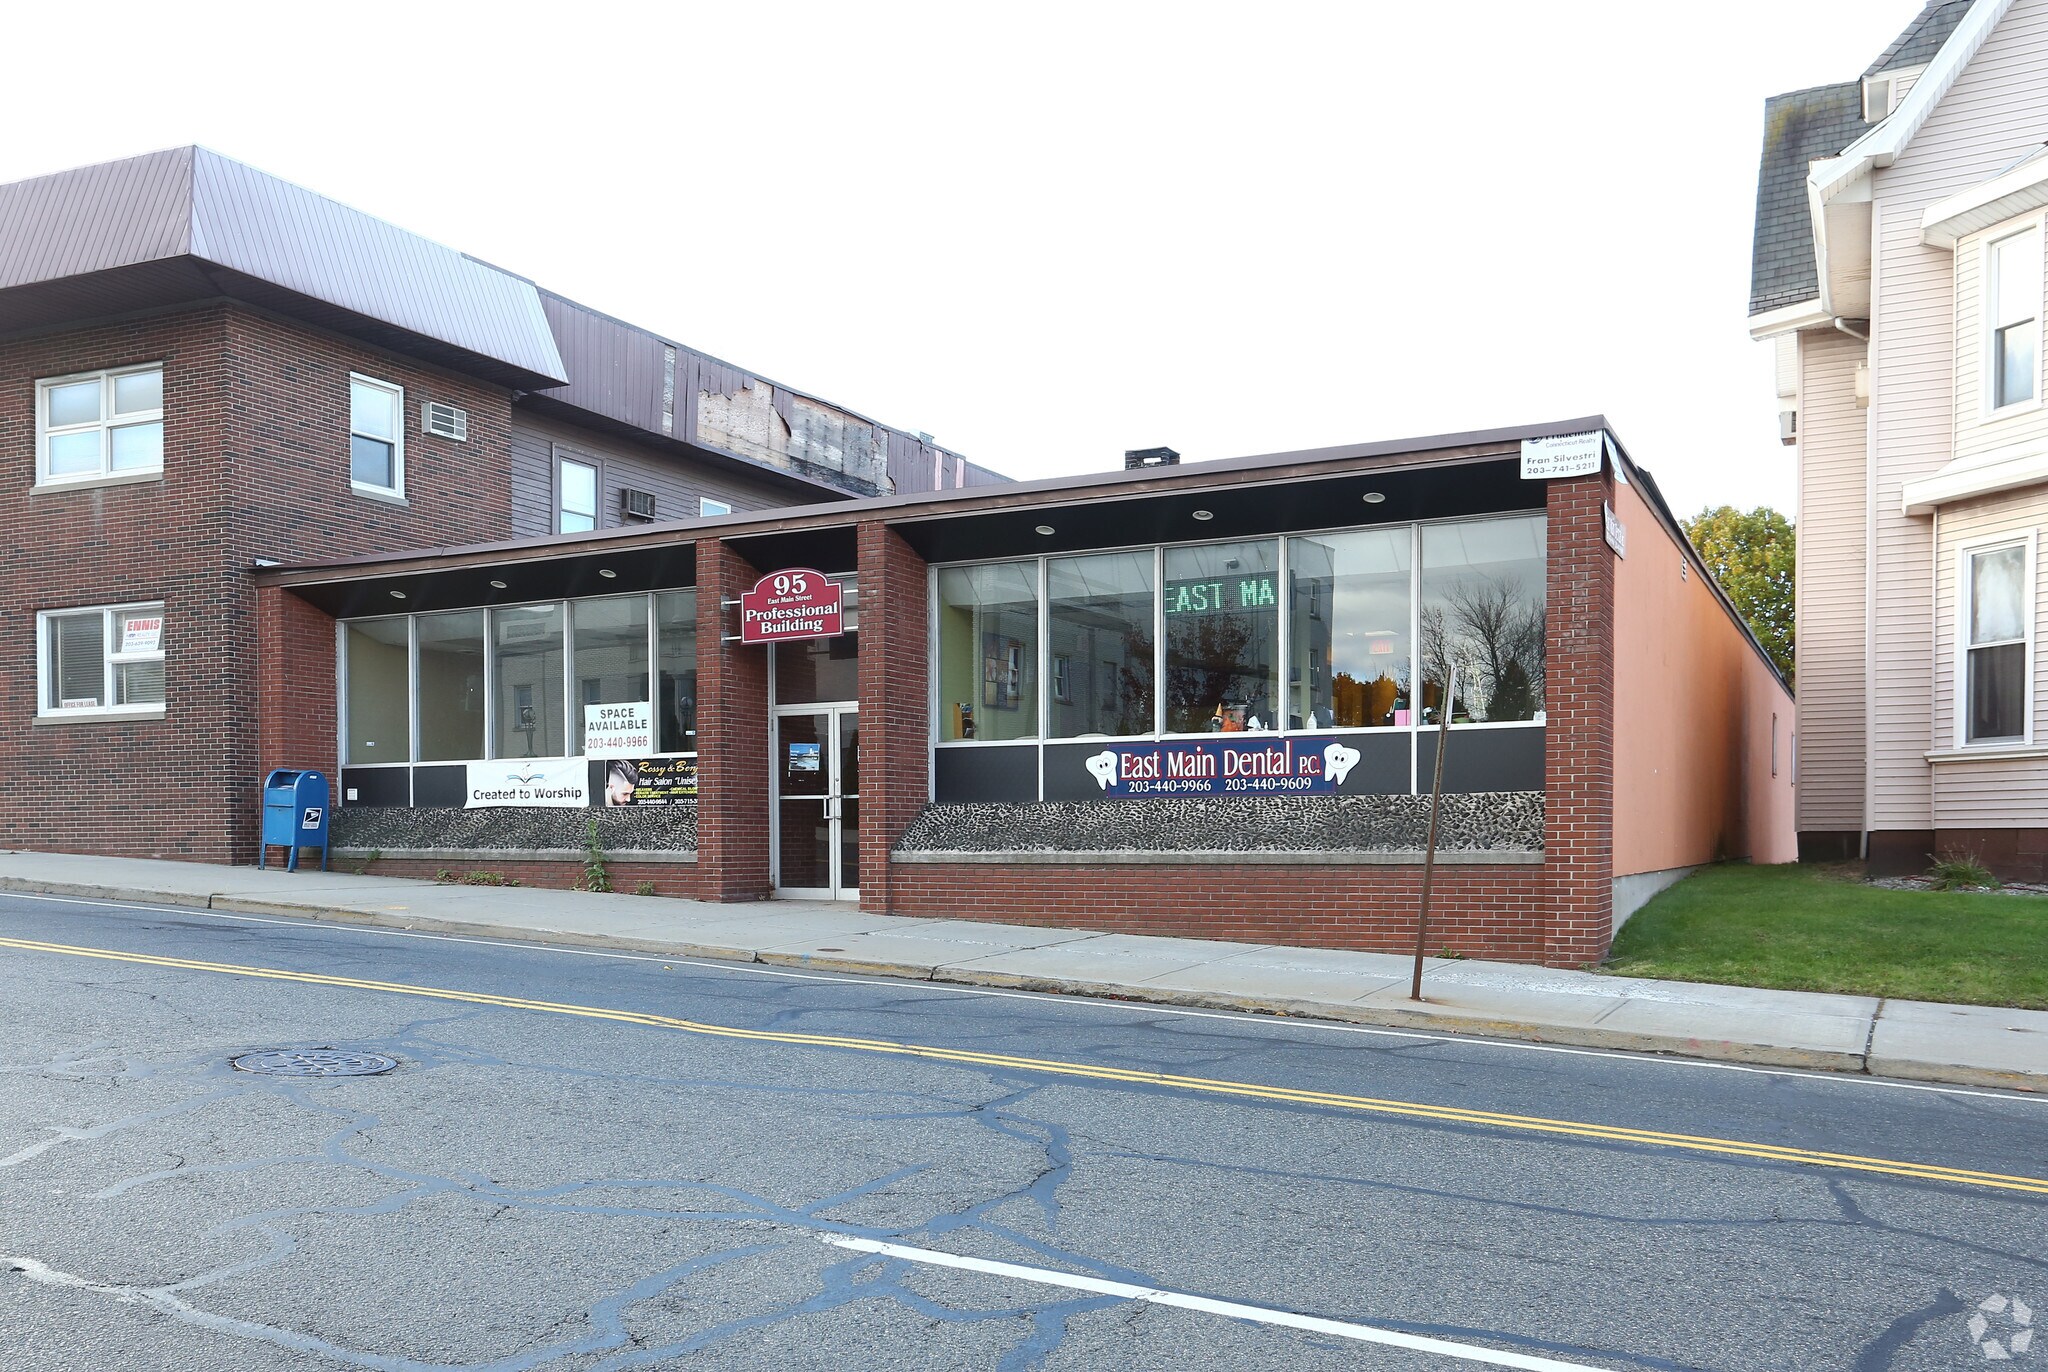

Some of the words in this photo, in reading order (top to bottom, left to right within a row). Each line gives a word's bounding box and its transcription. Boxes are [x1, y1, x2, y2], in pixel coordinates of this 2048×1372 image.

[1545, 441, 1577, 449] Connecticut
[1579, 438, 1597, 446] Realty
[1527, 457, 1550, 465] Fran
[1554, 451, 1596, 463] Silvestri
[1527, 462, 1595, 474] 203-741-5211
[773, 573, 807, 596] 95
[795, 594, 813, 602] Street
[1239, 579, 1275, 607] MA
[745, 601, 838, 622] Professional
[127, 619, 161, 631] ENNIS
[761, 618, 823, 634] Building
[600, 708, 634, 719] SPACE
[588, 719, 648, 731] AVAILABLE
[588, 735, 648, 749] 203-440-9966
[1120, 750, 1160, 779] East
[1167, 745, 1216, 778] Main
[1223, 740, 1290, 777] Dental
[1299, 754, 1321, 775] P.C.
[638, 761, 666, 776] Rossy
[667, 764, 675, 772] &
[638, 777, 653, 786] Hair
[653, 777, 673, 786] Salon
[1128, 779, 1212, 793] 203-440-9966
[1225, 777, 1312, 791] 203-440-9609
[473, 788, 516, 800] Created
[519, 790, 531, 799] to
[534, 787, 582, 800] Worship
